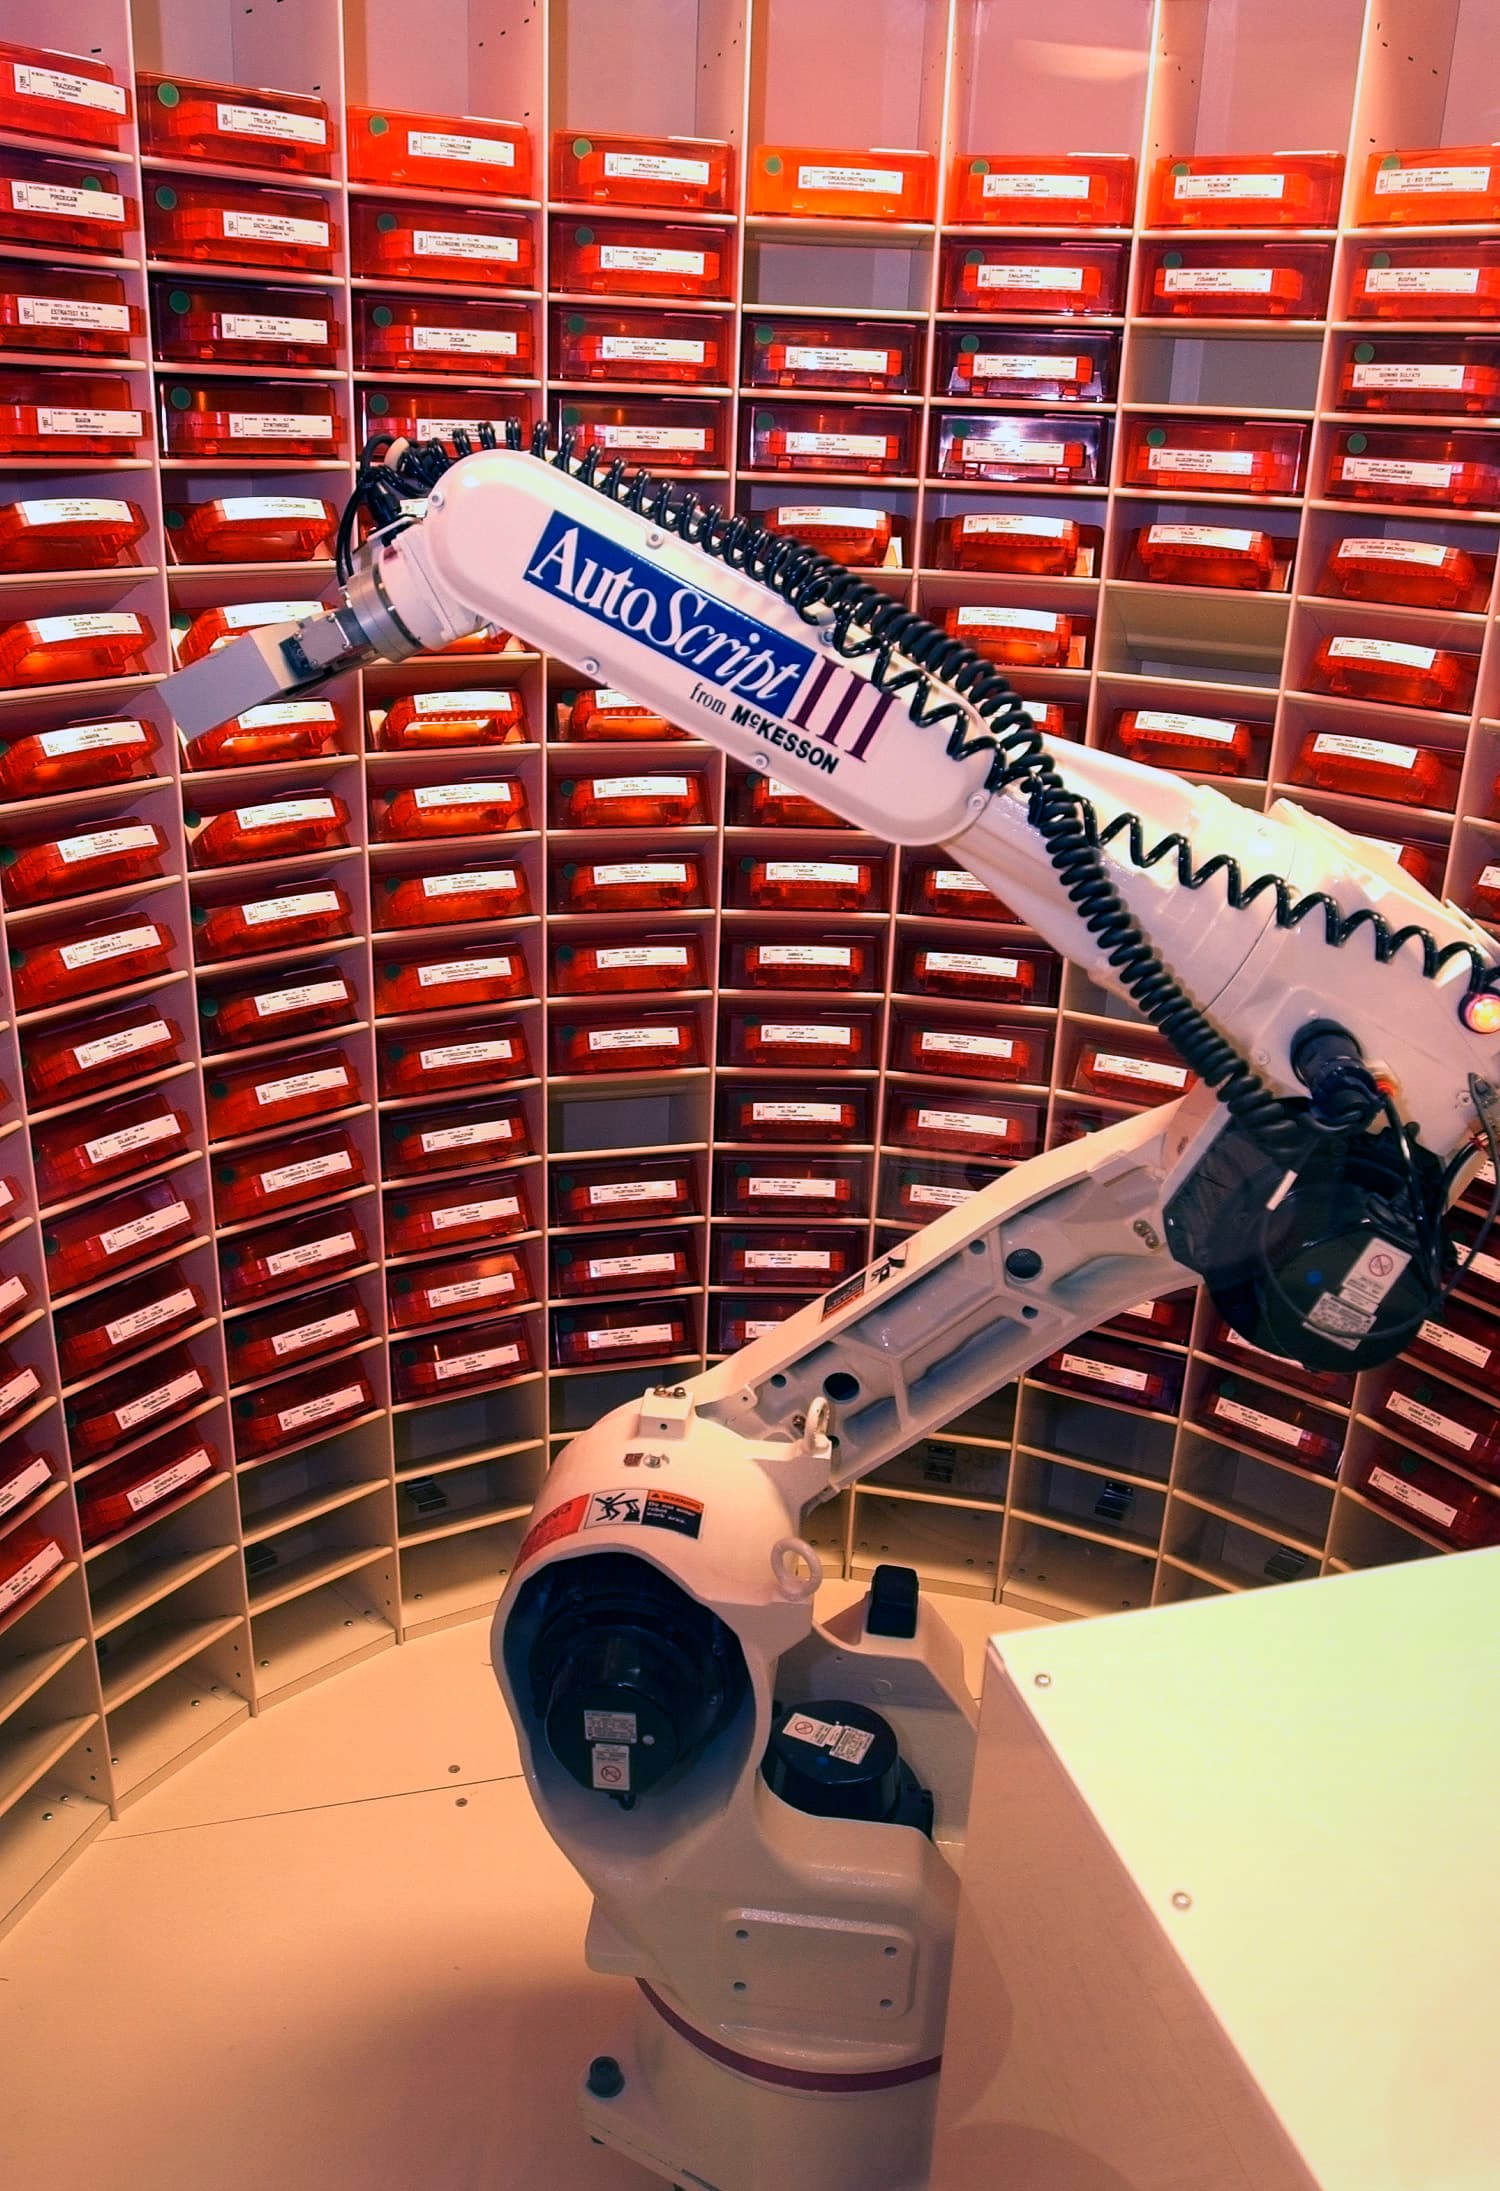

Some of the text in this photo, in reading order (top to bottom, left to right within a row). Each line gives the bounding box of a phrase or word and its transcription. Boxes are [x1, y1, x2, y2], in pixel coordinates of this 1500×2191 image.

[528, 527, 900, 763] AutoScript III
[690, 682, 727, 716] from
